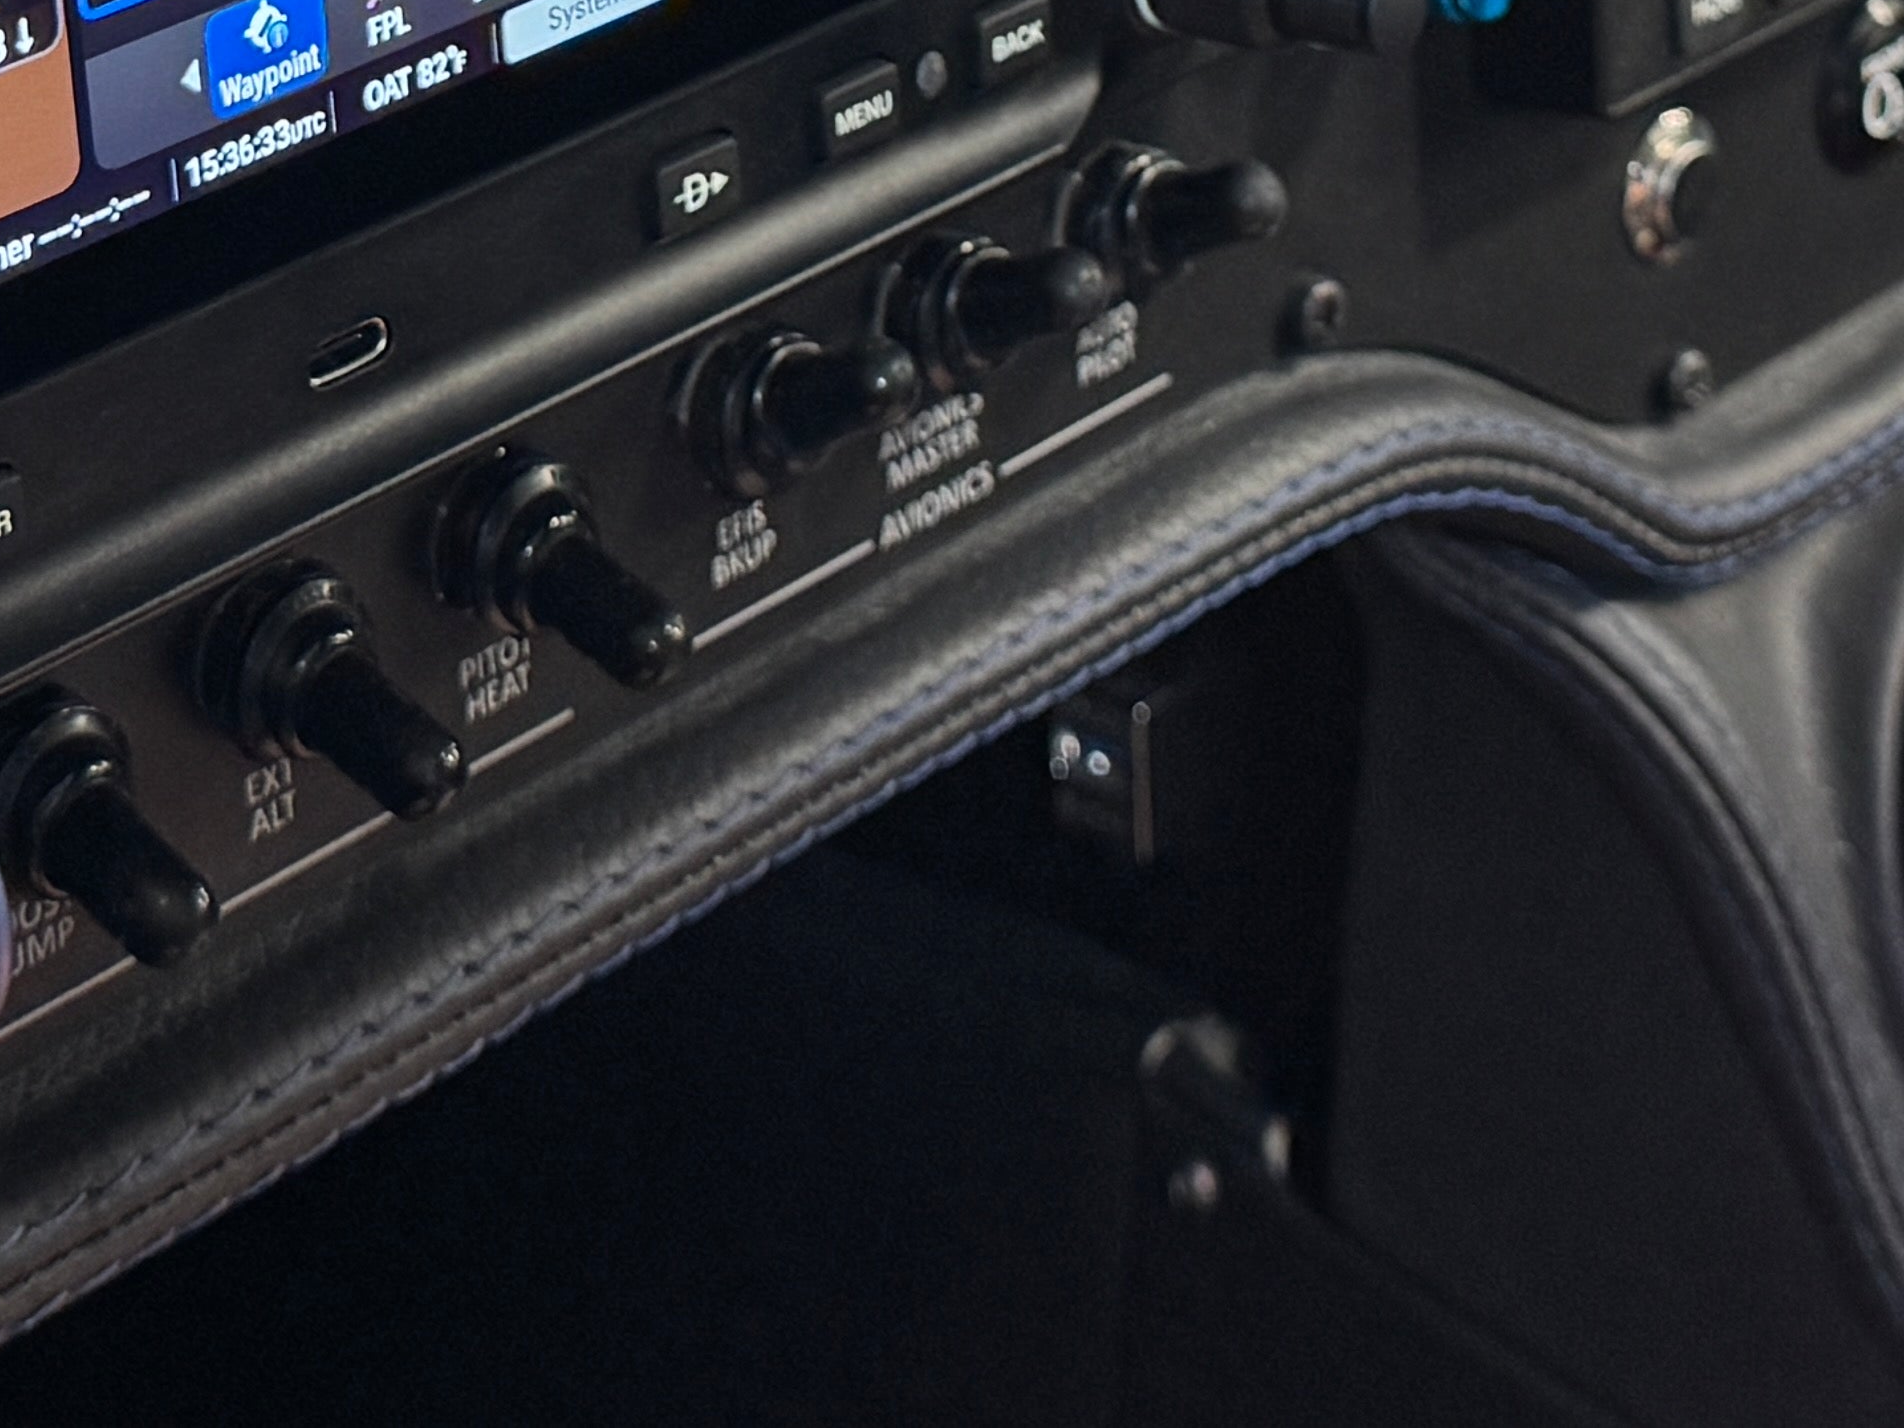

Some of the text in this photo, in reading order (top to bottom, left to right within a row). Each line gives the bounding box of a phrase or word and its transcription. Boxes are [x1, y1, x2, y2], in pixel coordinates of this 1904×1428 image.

[365, 8, 411, 46] FPL
[992, 19, 1046, 63] BACK
[220, 44, 322, 108] Waypoint
[362, 69, 410, 112] OAT
[835, 91, 894, 138] MENU
[879, 461, 994, 551] AVIONICS
[466, 660, 532, 723] HEAT
[249, 795, 295, 842] ALT
